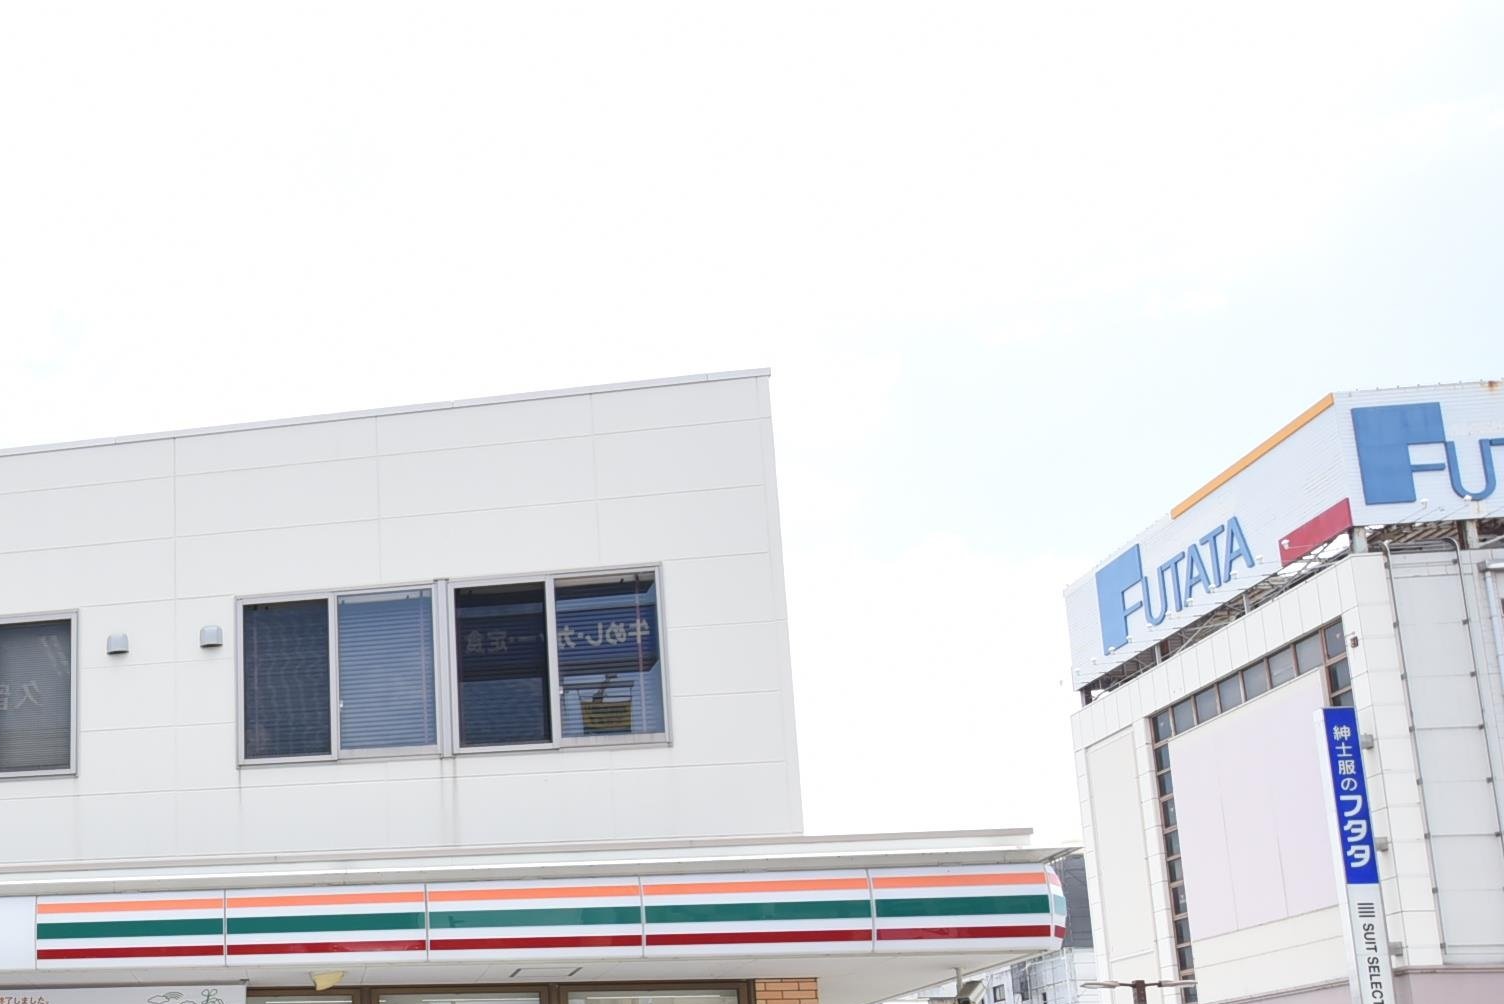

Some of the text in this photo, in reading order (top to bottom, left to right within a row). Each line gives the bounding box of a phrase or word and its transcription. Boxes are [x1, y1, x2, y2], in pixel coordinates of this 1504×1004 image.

[1351, 401, 1504, 505] FU
[1095, 515, 1255, 655] FUTATA
[1333, 724, 1371, 868] 紳士服のフタタ
[1362, 922, 1378, 952] SUIT
